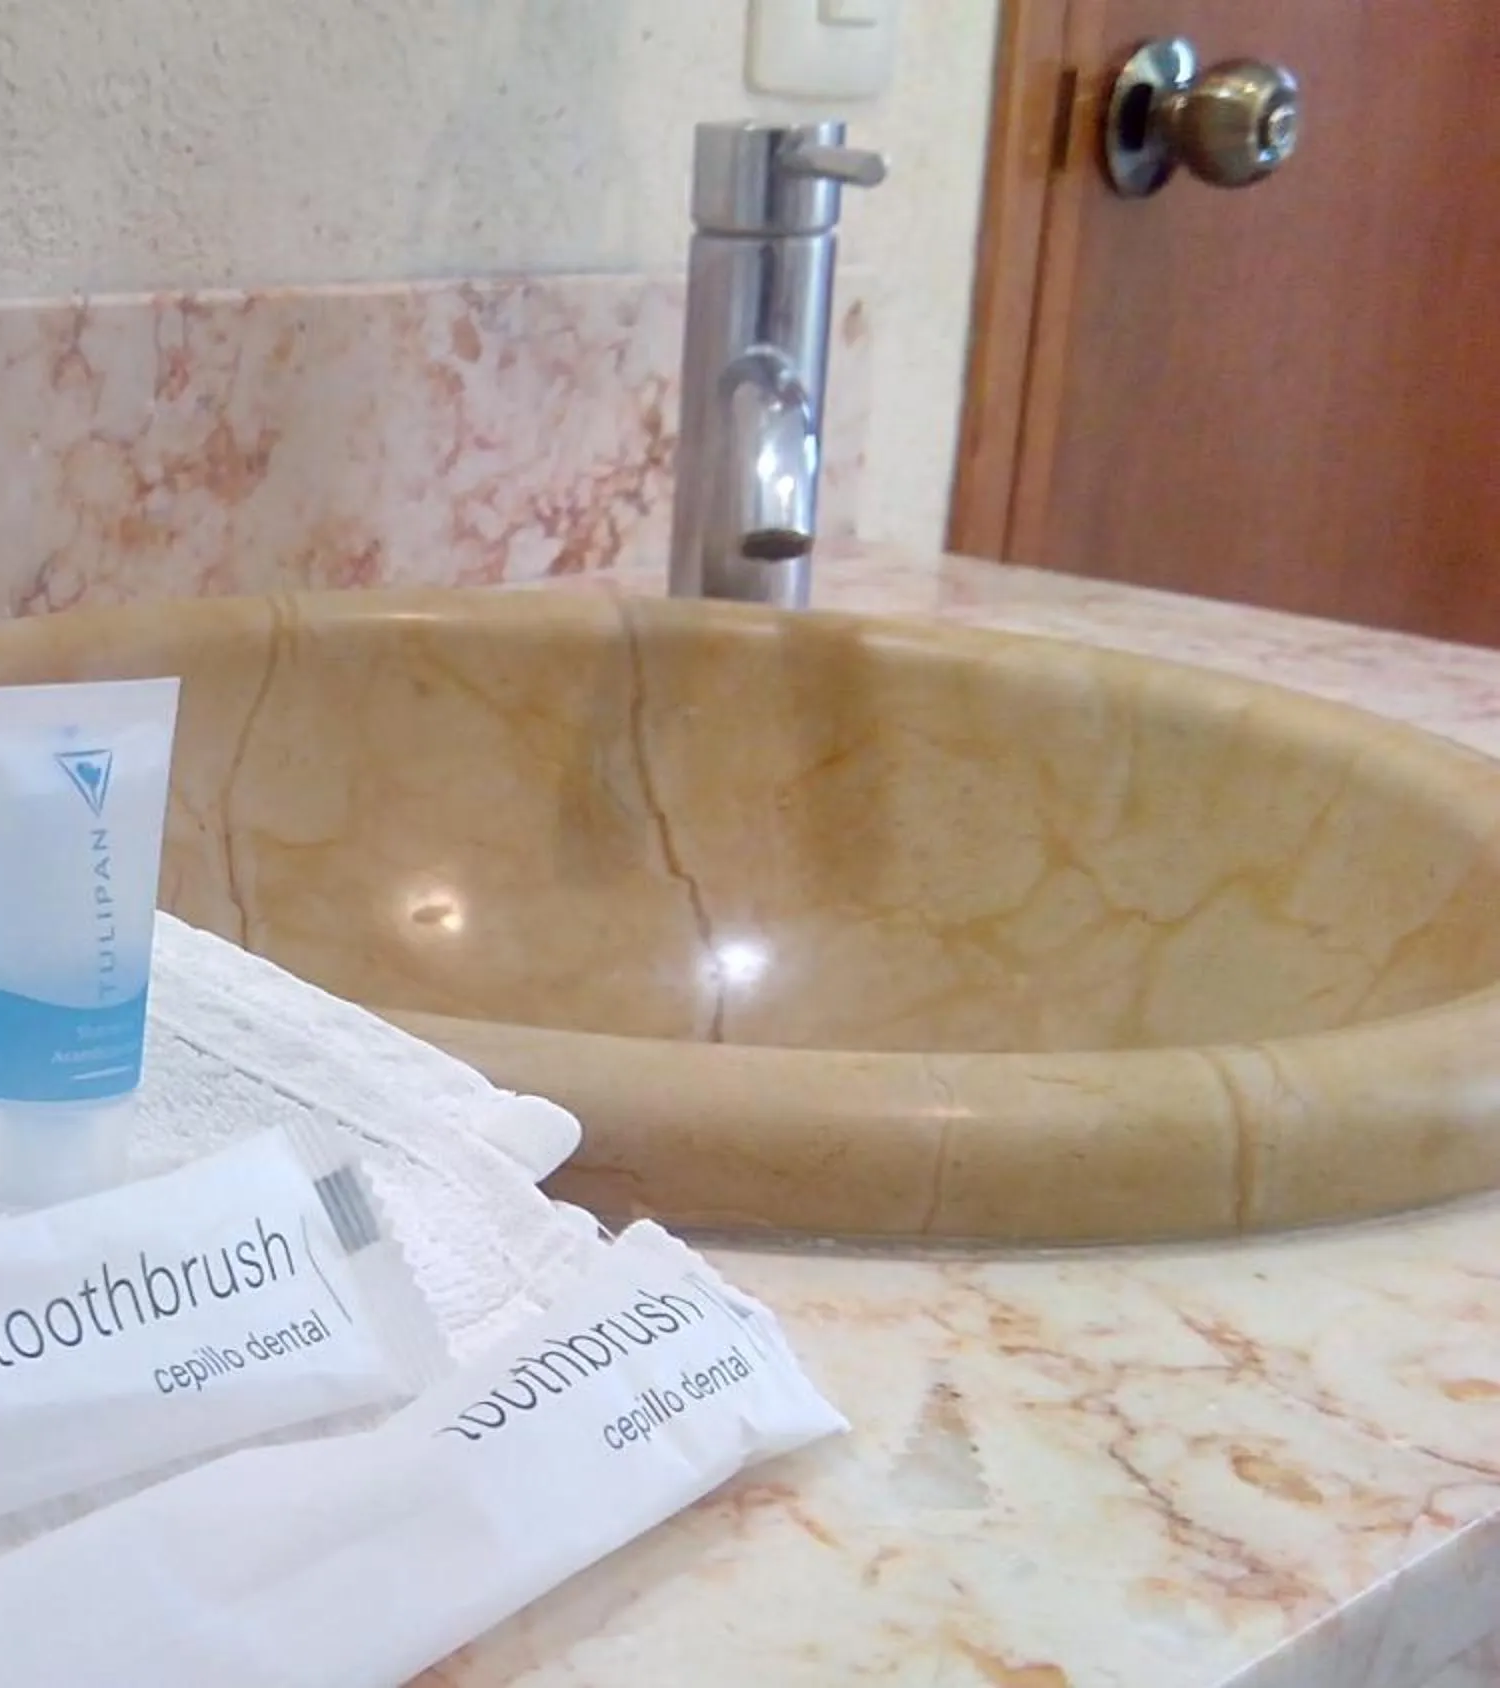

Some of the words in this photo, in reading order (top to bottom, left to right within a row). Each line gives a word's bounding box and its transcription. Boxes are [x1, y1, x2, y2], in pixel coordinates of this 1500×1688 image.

[90, 827, 117, 997] TULIPAN
[152, 1344, 246, 1394] cepillo
[244, 1308, 332, 1362] dental
[602, 1388, 685, 1451] cepillo
[680, 1345, 756, 1400] dental
